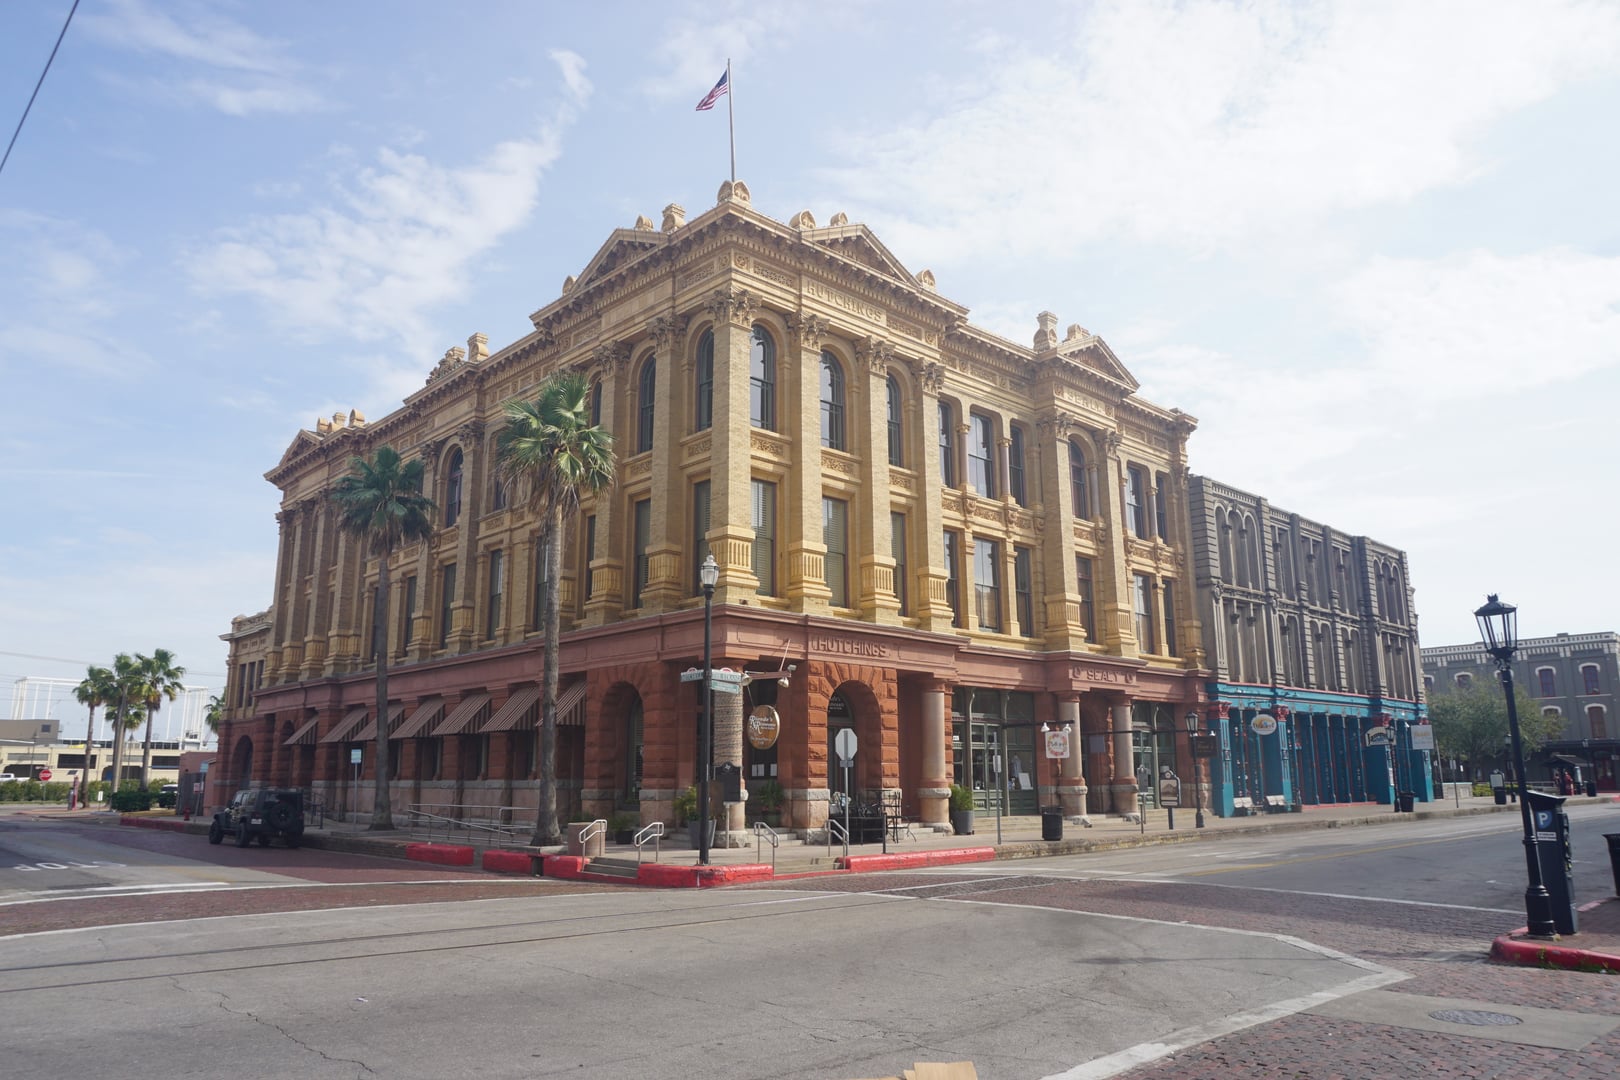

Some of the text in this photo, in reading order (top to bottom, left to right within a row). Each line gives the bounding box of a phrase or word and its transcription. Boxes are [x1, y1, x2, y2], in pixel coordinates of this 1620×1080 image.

[806, 280, 882, 322] HUTCHINGS
[819, 637, 888, 658] HUTCHINGS
[1086, 668, 1118, 682] SEALY
[1538, 812, 1549, 825] P
